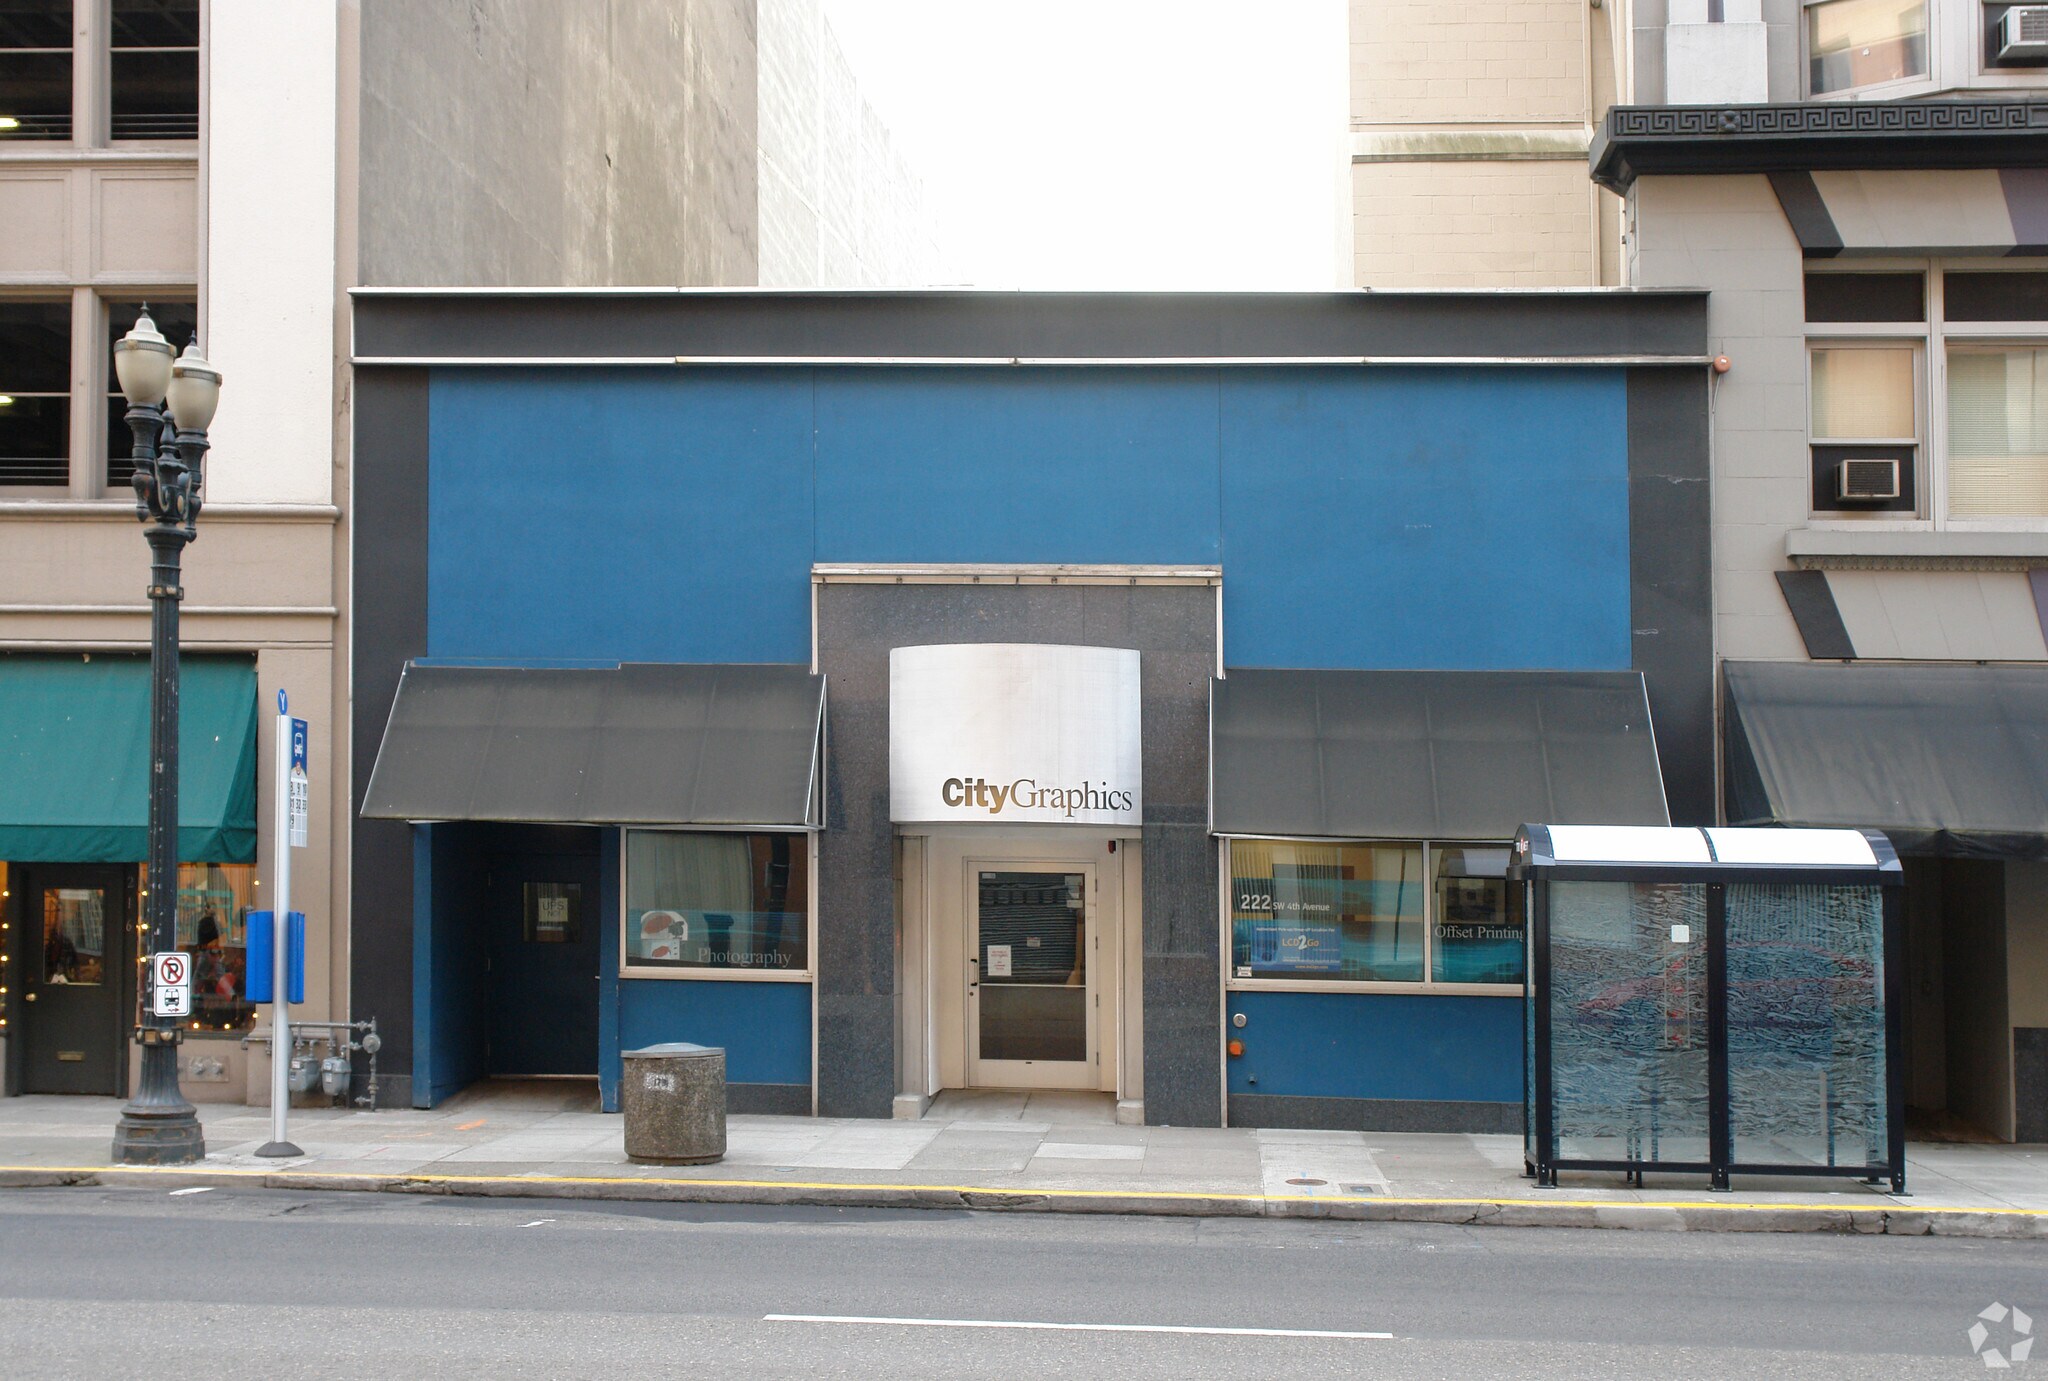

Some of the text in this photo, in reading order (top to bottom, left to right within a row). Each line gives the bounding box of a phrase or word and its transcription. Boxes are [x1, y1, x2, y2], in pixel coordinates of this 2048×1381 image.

[279, 693, 286, 710] Y
[942, 778, 1133, 818] CityGraphics
[542, 900, 565, 911] UPS
[1241, 894, 1331, 912] 222 SW 4th Avenue
[1434, 925, 1473, 938] Offset
[1282, 935, 1319, 951] LCD2Go
[698, 947, 792, 967] Photography
